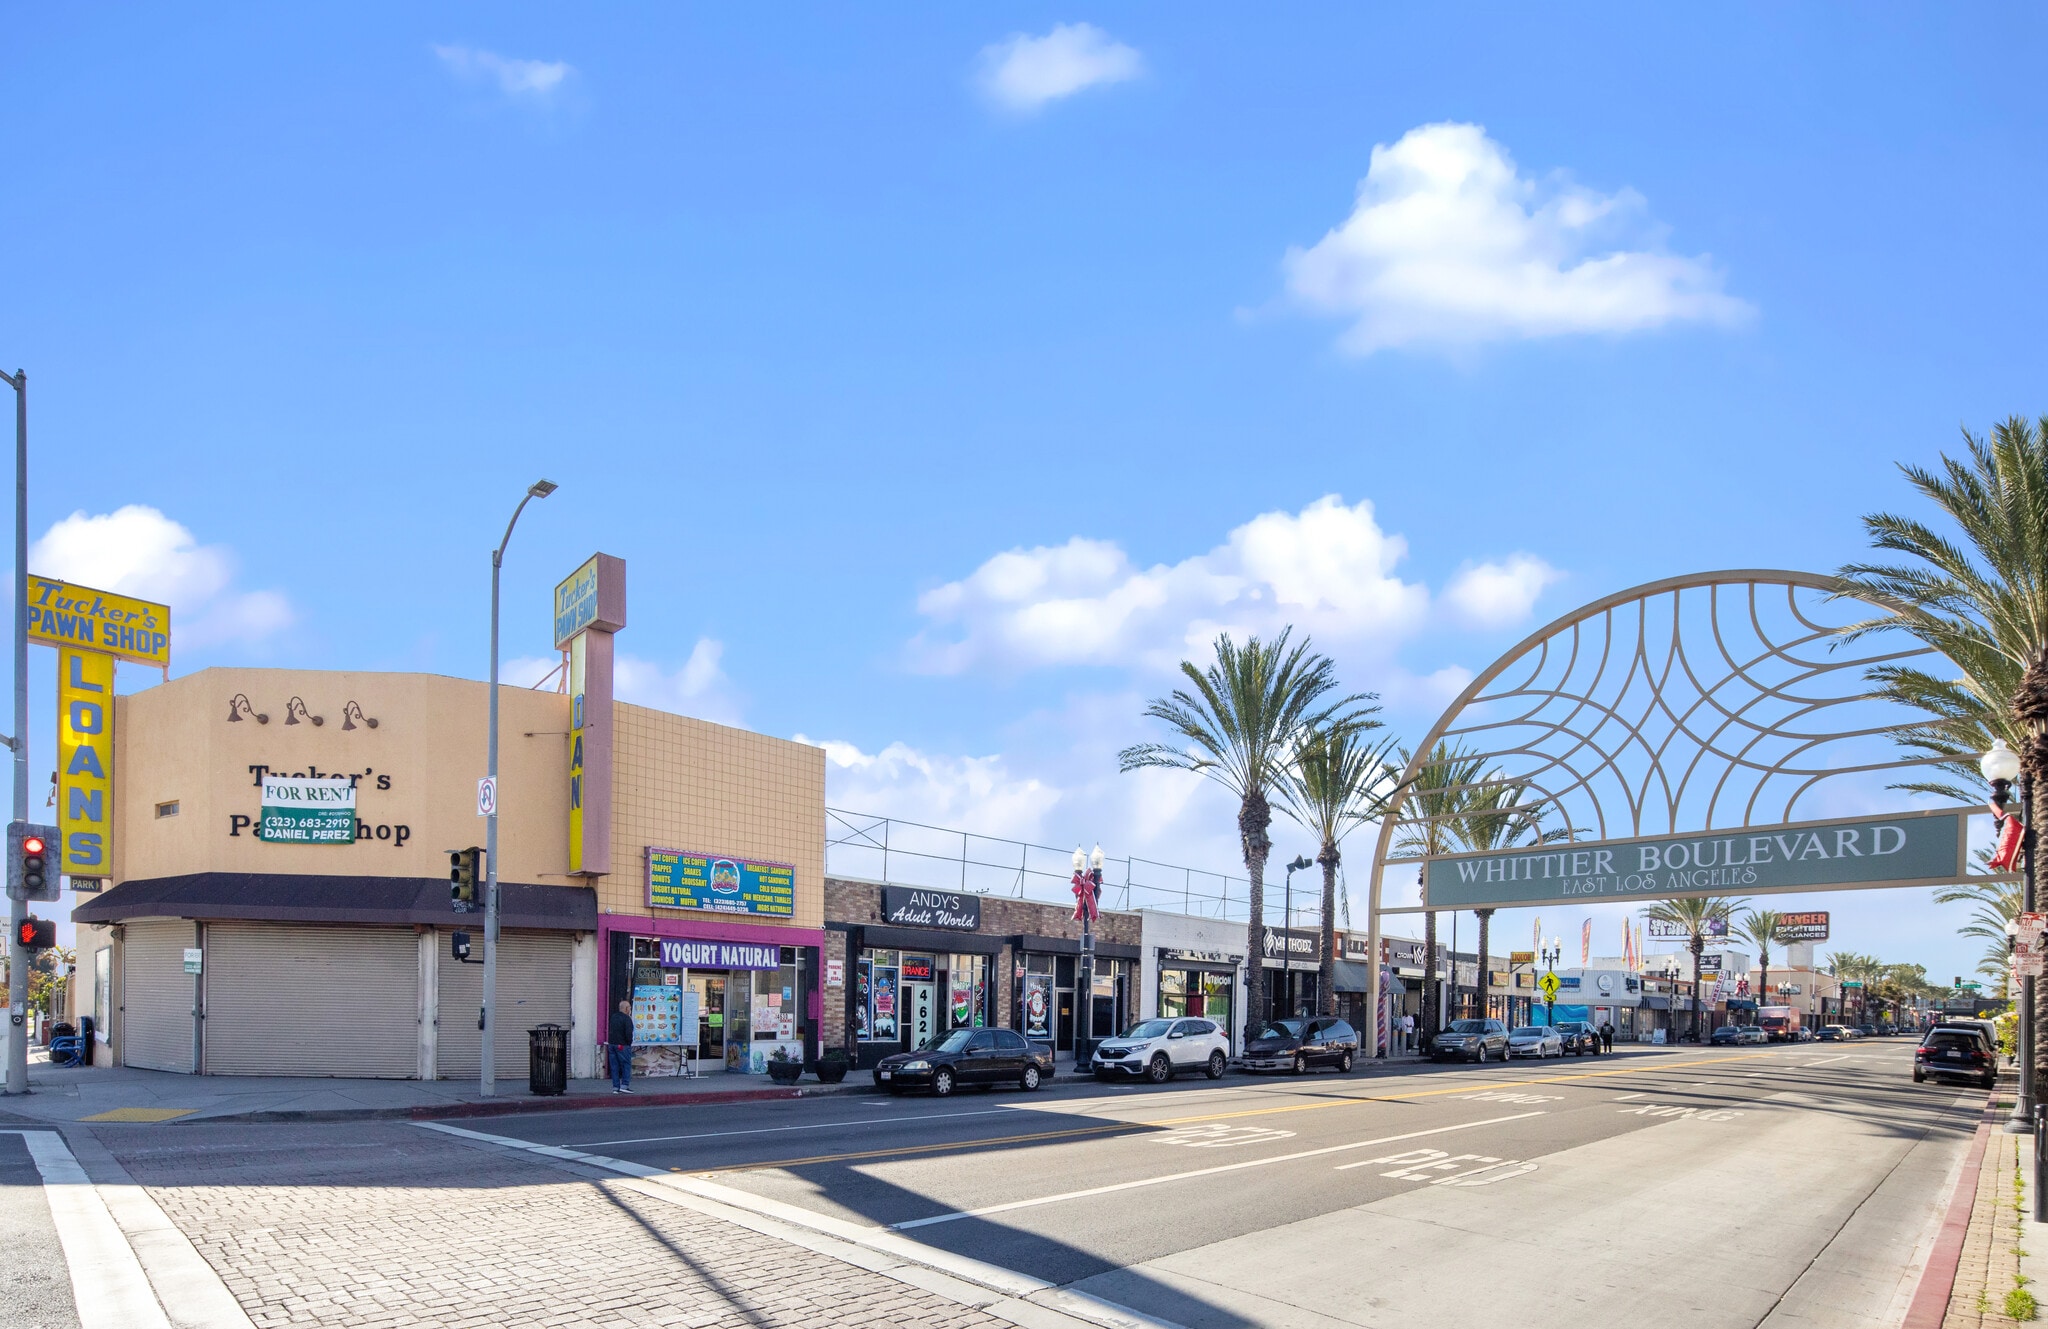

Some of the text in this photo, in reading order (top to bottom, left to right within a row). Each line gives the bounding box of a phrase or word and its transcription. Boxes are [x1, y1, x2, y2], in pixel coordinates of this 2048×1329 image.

[560, 568, 596, 613] Tucker's
[34, 581, 158, 630] Tucker's
[28, 606, 167, 655] PAWN SHOP
[66, 654, 106, 866] LOANS
[265, 785, 354, 801] FOR RENT
[265, 816, 351, 829] (323) 683-2919
[264, 828, 350, 840] DANIEL PEREZ
[354, 818, 411, 847] hop
[662, 855, 678, 864] COFFEE
[683, 857, 691, 865] ICE
[691, 858, 707, 867] COFFEE
[1456, 825, 1907, 884] WHITTIER BOULEVARD
[651, 864, 672, 873] FRAPPES
[684, 867, 701, 876] SHAKES
[72, 879, 95, 890] PARK
[651, 875, 671, 884] DONUTS
[682, 877, 707, 887] CROISSANT
[1562, 866, 1758, 895] EAST LOS ANGELES
[651, 885, 691, 896] YOGURT NATURAL
[680, 898, 697, 906] MUFFIN
[909, 891, 960, 911] ANDY'S
[891, 906, 975, 928] Adult World
[662, 942, 777, 968] YOGURT NATURAL
[1617, 1104, 1745, 1122] XING
